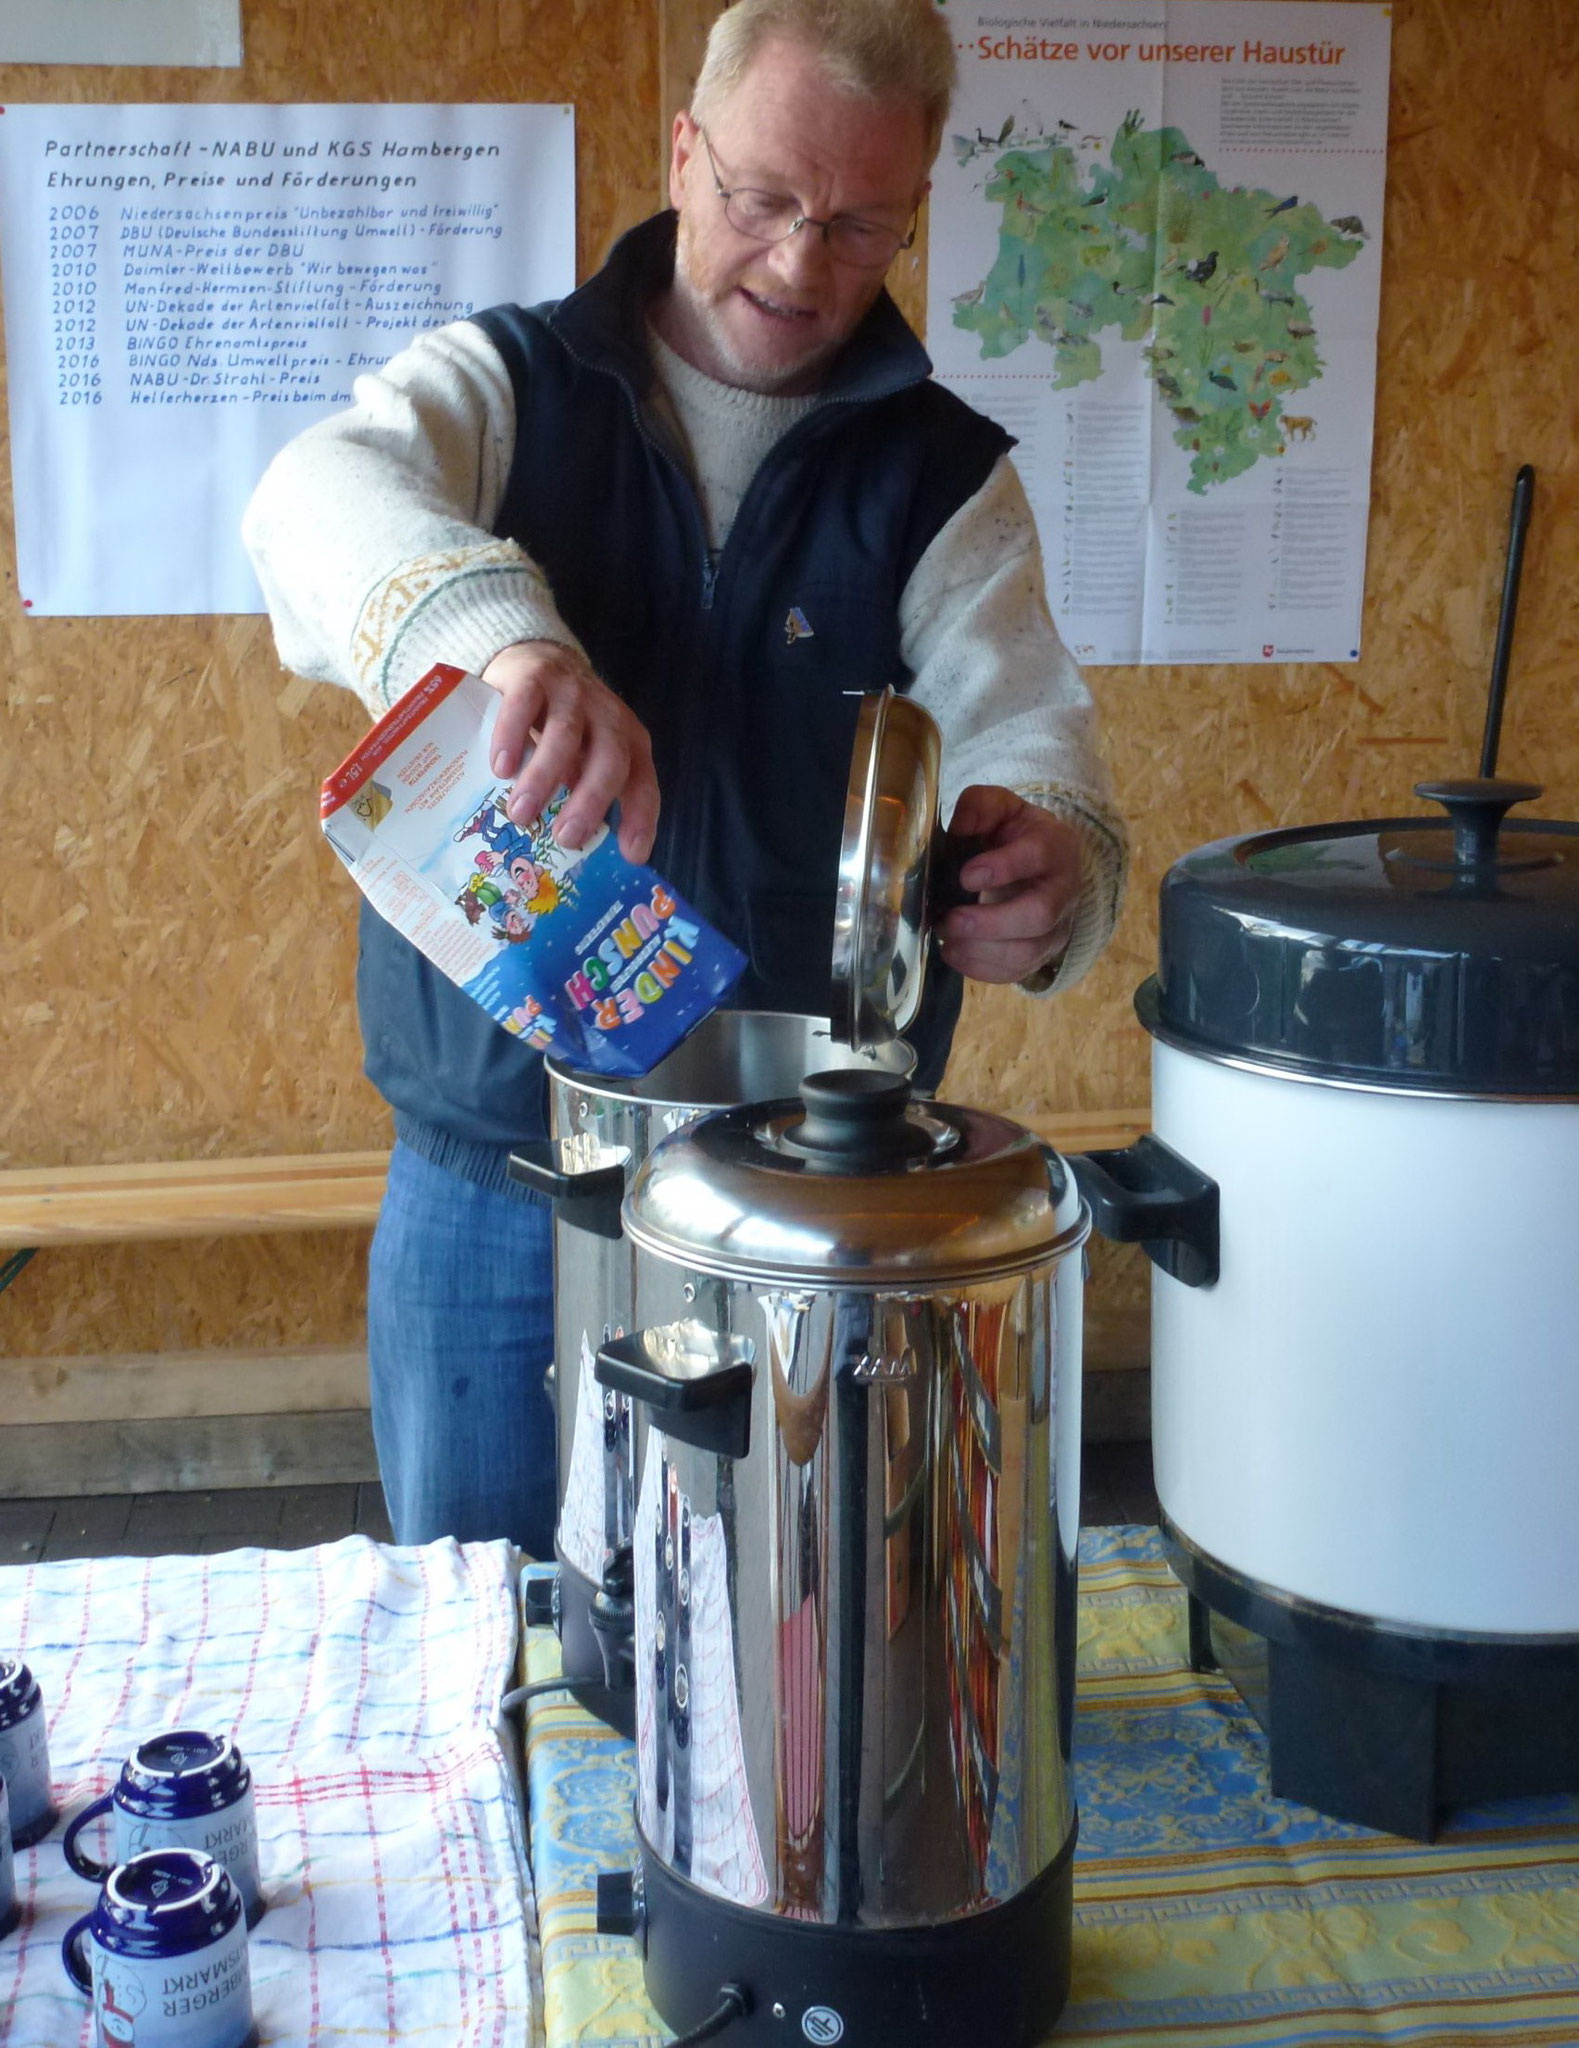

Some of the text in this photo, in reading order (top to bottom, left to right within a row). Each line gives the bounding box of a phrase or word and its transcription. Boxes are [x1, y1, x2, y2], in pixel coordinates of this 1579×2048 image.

[978, 17, 1036, 29] Biologische
[1041, 17, 1076, 28] Vielfalt
[1080, 18, 1089, 28] in
[978, 35, 1346, 65] Schätze vor unserer Haustür
[45, 140, 192, 157] Partnerschaft
[283, 142, 319, 157] und
[328, 141, 373, 157] KGS
[382, 142, 500, 160] Hambergen
[47, 172, 417, 191] Ehrungen, Preise und Förderungen
[50, 205, 99, 221] 2006
[121, 206, 288, 223] Niedersachsenpreis
[401, 206, 427, 219] und
[50, 225, 98, 240] 2007
[121, 226, 152, 239] DBU
[232, 224, 348, 240] Bundesstiftung
[429, 223, 503, 239] Förderung
[50, 244, 304, 259] 2007 MUNA-Preis der DBU
[51, 263, 97, 278] 2010
[337, 262, 397, 277] bewegen
[52, 281, 97, 296] 2010
[360, 280, 441, 296] Förderung
[53, 300, 96, 314] 2012
[126, 299, 214, 313] UN-Dekade
[221, 299, 244, 312] der
[249, 299, 350, 313] Artenvielfalt
[365, 297, 474, 313] Auszeichnung
[54, 318, 96, 333] 2012
[222, 317, 245, 330] der
[248, 316, 348, 330] Artenvielfalt
[366, 315, 417, 330] Projekt
[55, 336, 307, 351] 2013 BINGO Ehrenamtspreis
[58, 354, 100, 369] 2016
[129, 354, 180, 367] BINGO
[228, 353, 330, 370] Umweltpreis
[58, 373, 101, 388] 2016
[279, 371, 320, 384] Preis
[60, 391, 102, 405] 2016
[131, 390, 238, 404] Helferherzen
[293, 389, 326, 402] beim
[564, 883, 676, 1010] PUNSCH
[591, 915, 700, 1030] KINDER
